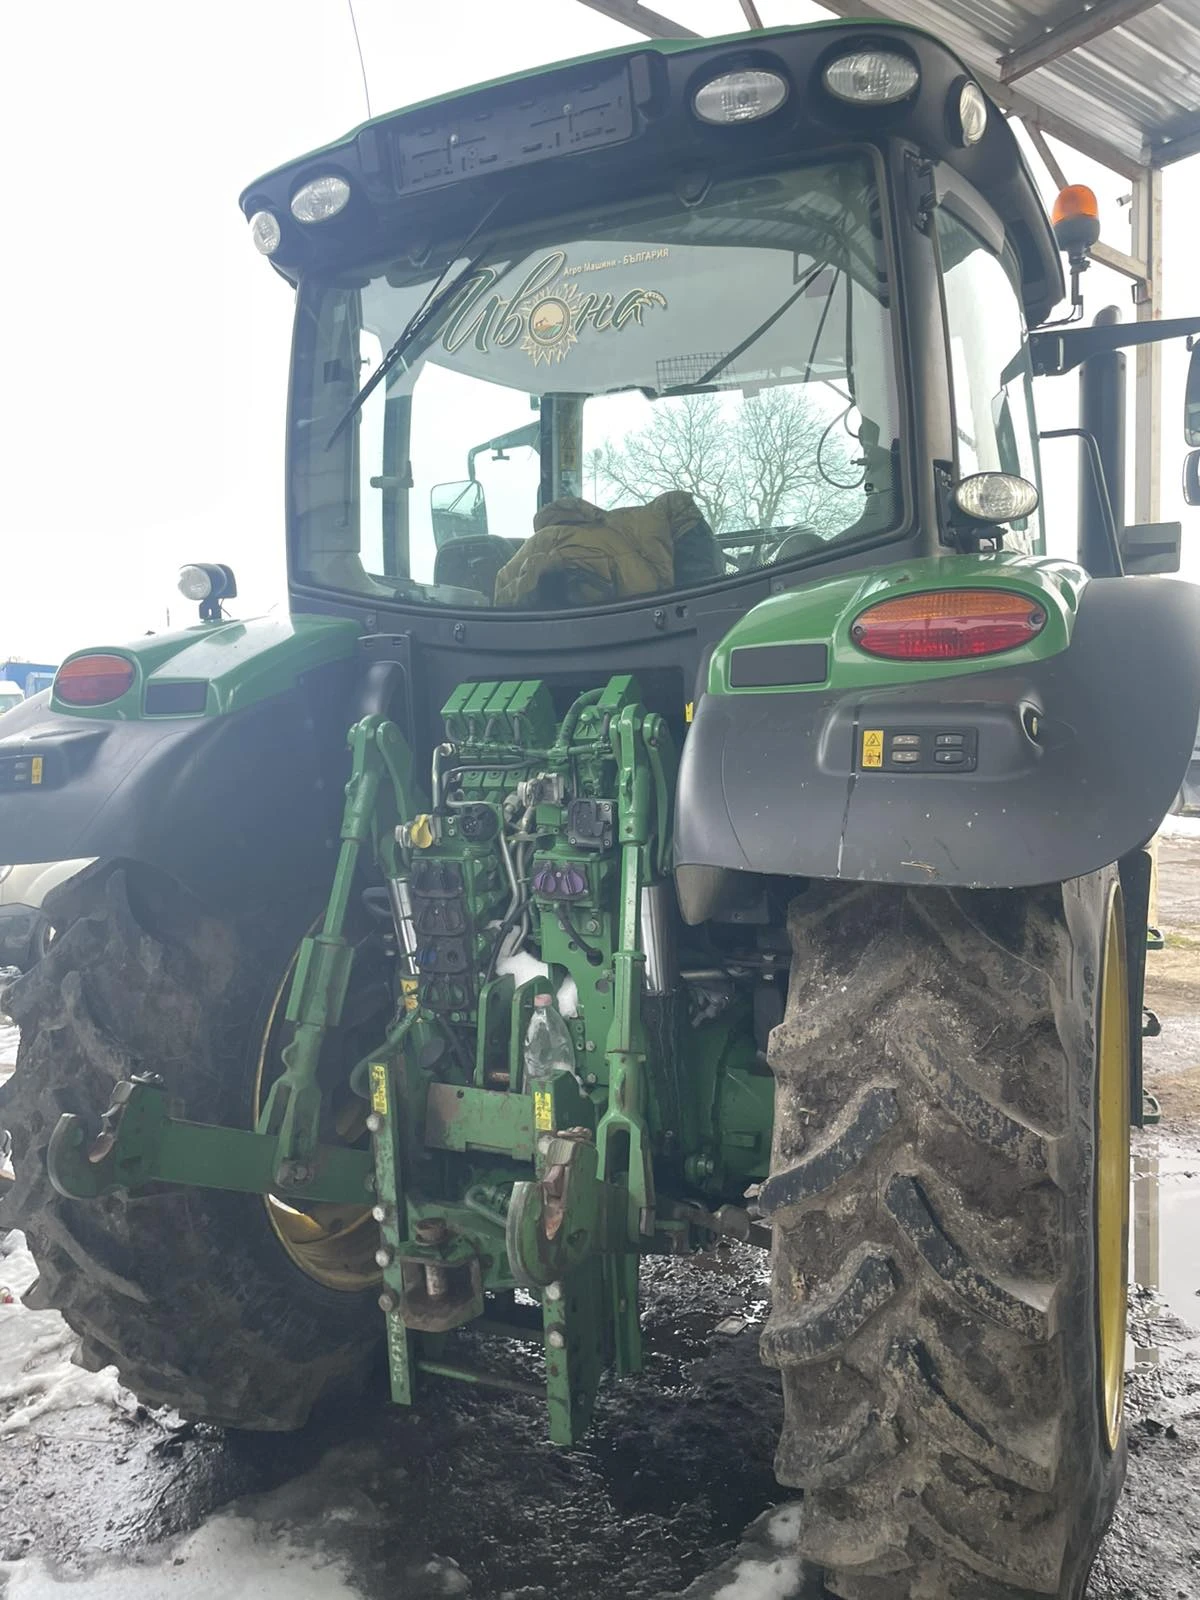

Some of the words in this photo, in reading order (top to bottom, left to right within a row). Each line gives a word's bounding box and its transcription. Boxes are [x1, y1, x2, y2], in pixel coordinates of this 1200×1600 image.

[563, 264, 582, 277] Агро
[584, 259, 617, 272] Машини
[623, 247, 669, 265] БЪЛГАРИЯ
